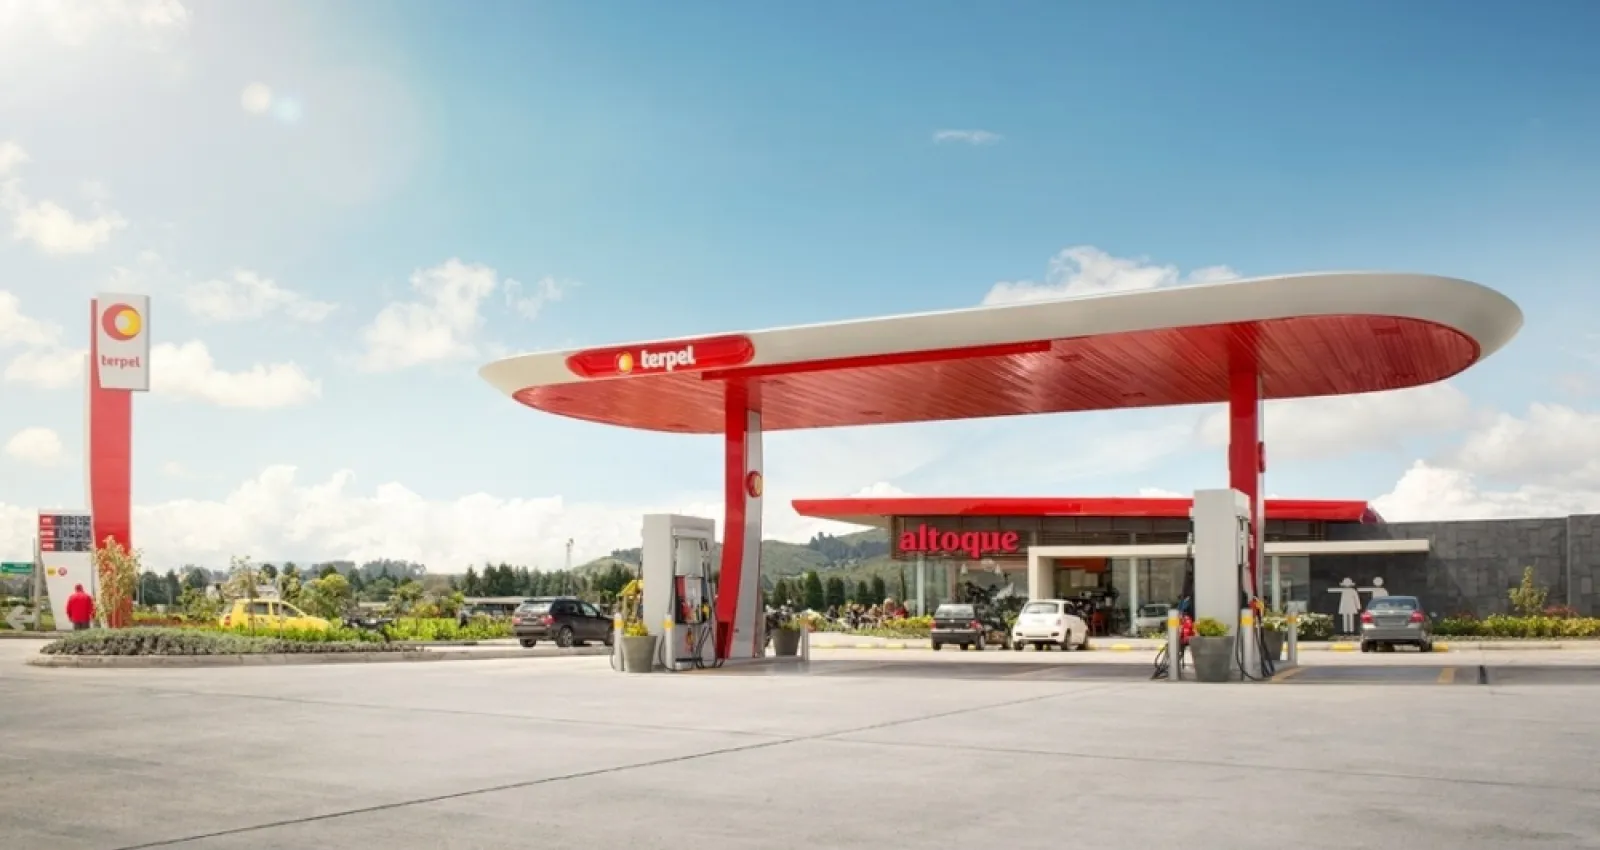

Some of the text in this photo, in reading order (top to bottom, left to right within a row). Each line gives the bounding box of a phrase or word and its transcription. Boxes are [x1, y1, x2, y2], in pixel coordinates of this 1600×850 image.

[101, 355, 141, 369] terpel
[641, 345, 695, 371] terpel
[900, 522, 1019, 558] altoque
